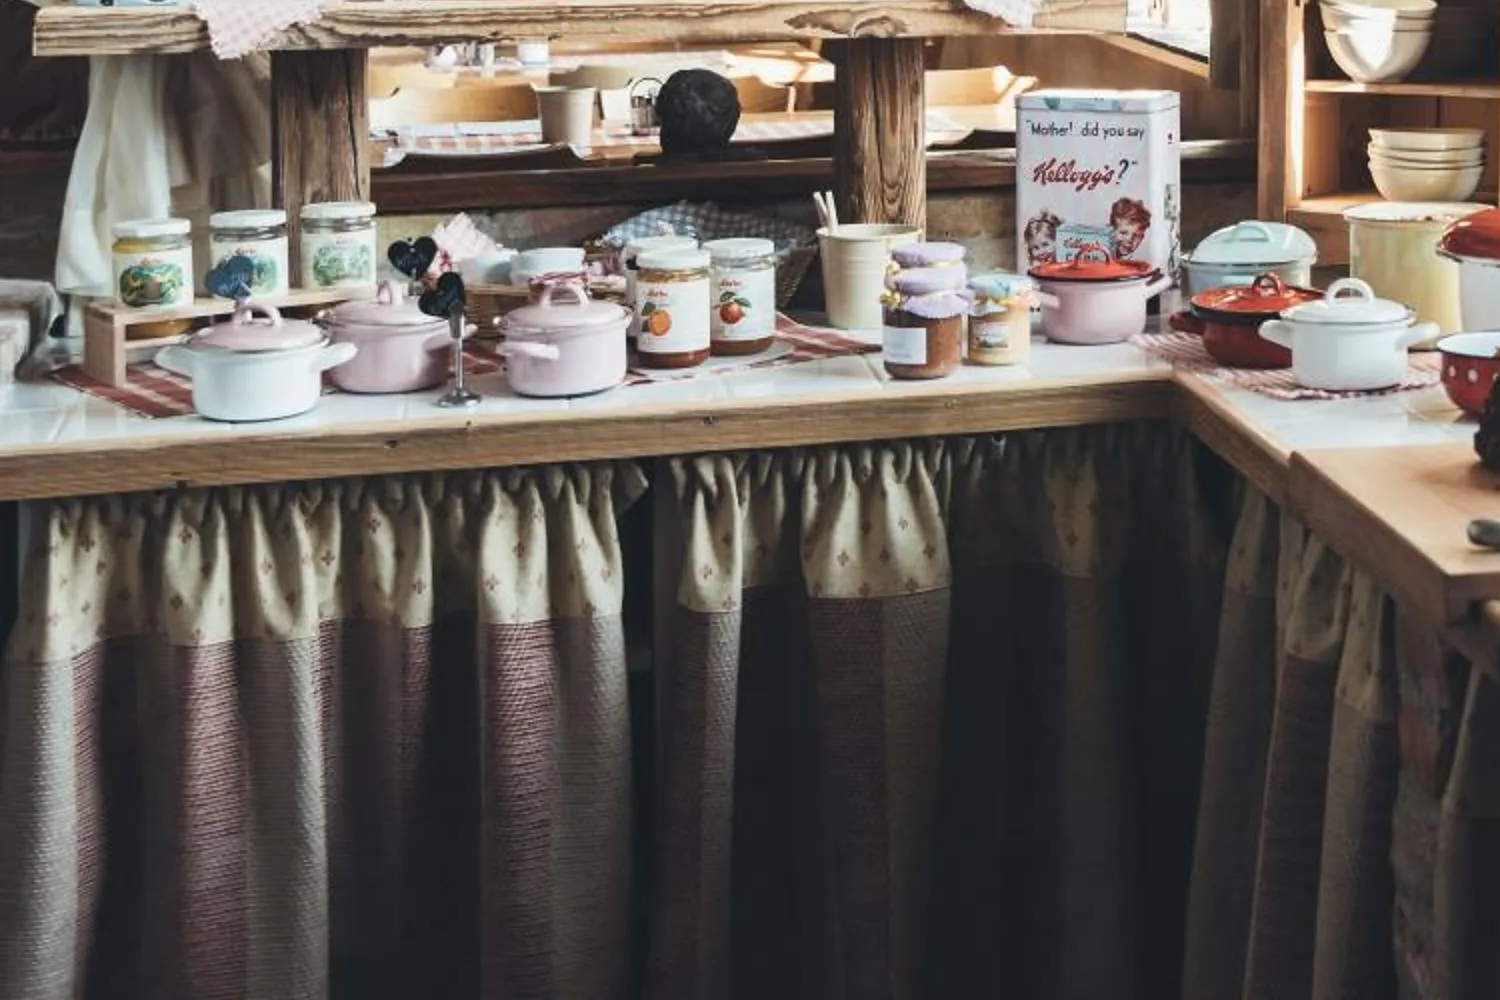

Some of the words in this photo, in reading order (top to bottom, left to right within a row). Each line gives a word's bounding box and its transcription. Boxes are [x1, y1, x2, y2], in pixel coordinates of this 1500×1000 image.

[1081, 121, 1099, 137] did
[1102, 127, 1125, 141] you
[1127, 127, 1145, 141] say
